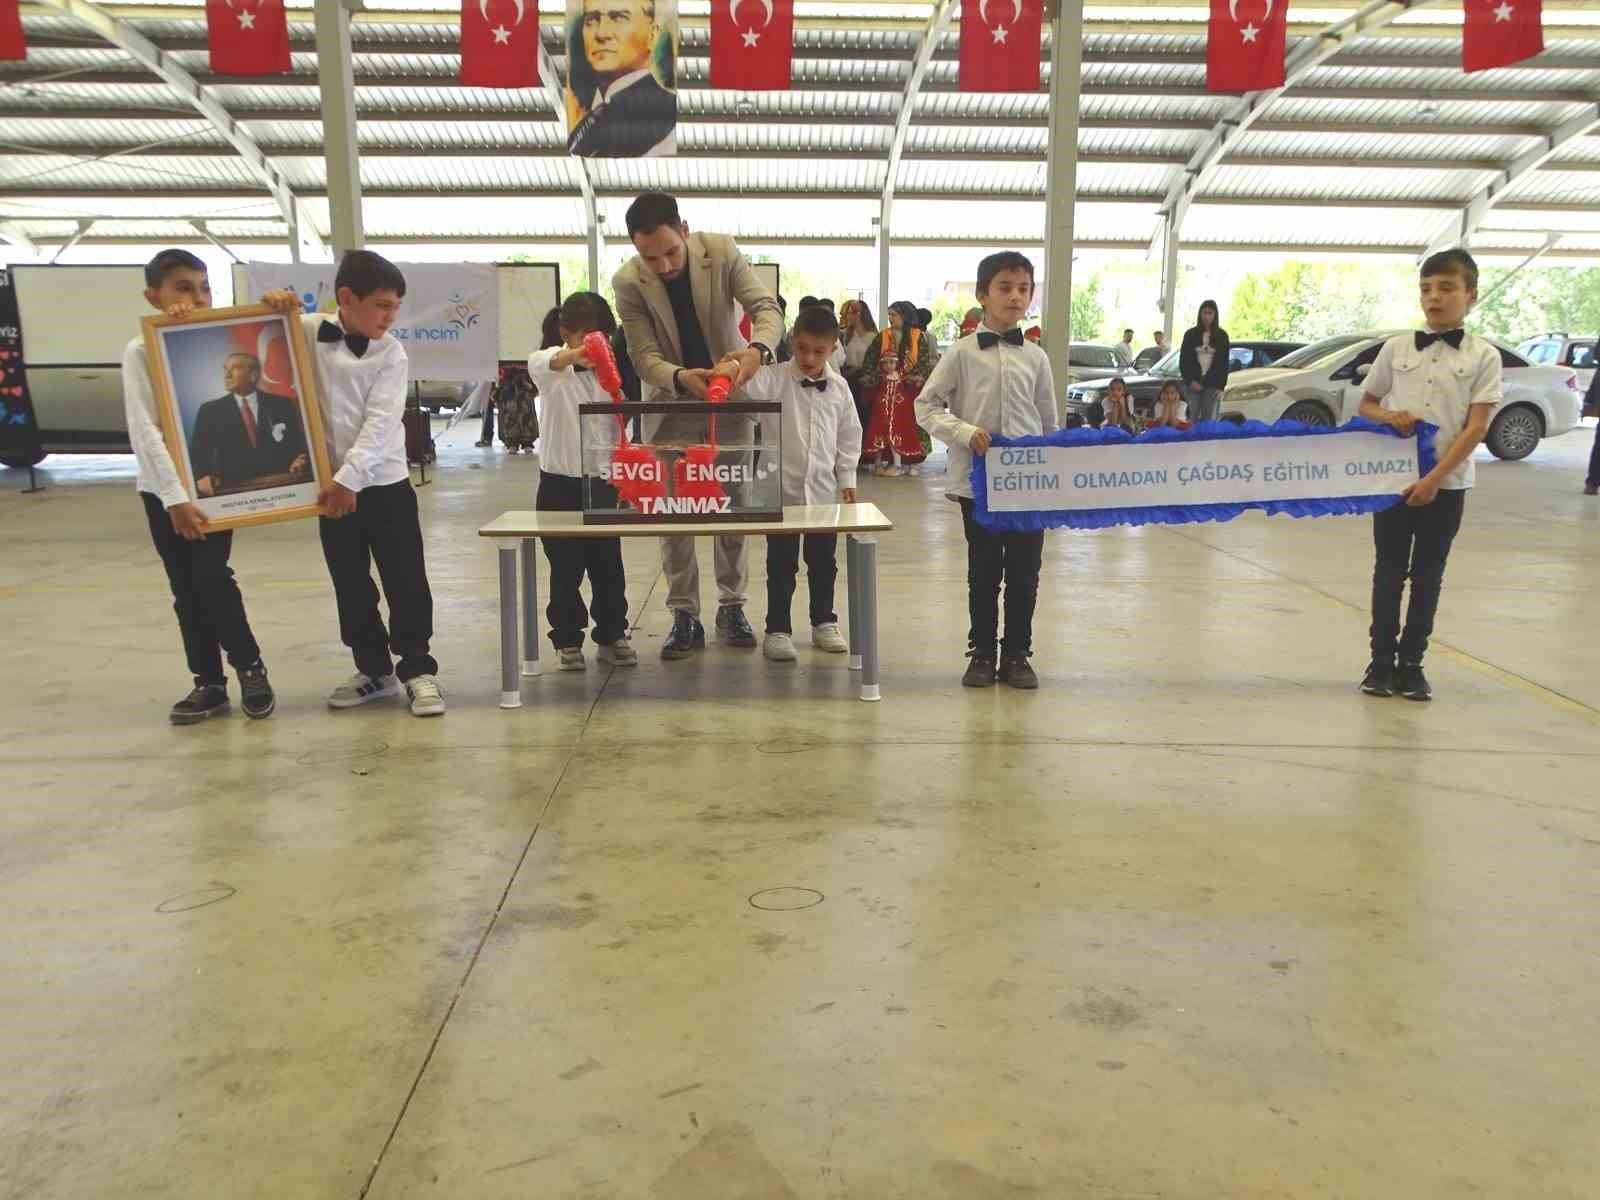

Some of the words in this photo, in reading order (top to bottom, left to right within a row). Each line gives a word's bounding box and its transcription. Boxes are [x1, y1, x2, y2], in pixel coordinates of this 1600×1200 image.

[1000, 447, 1046, 466] ÖZEL
[686, 463, 753, 482] ENGEL
[993, 472, 1059, 491] EĞİTİM
[1073, 470, 1168, 488] OLMADAN
[1177, 460, 1255, 485] ÇAĞDAŞ
[1263, 461, 1329, 482] EĞİTİM
[1345, 458, 1412, 476] OLMAZ!
[639, 496, 731, 514] TANIMAZ
